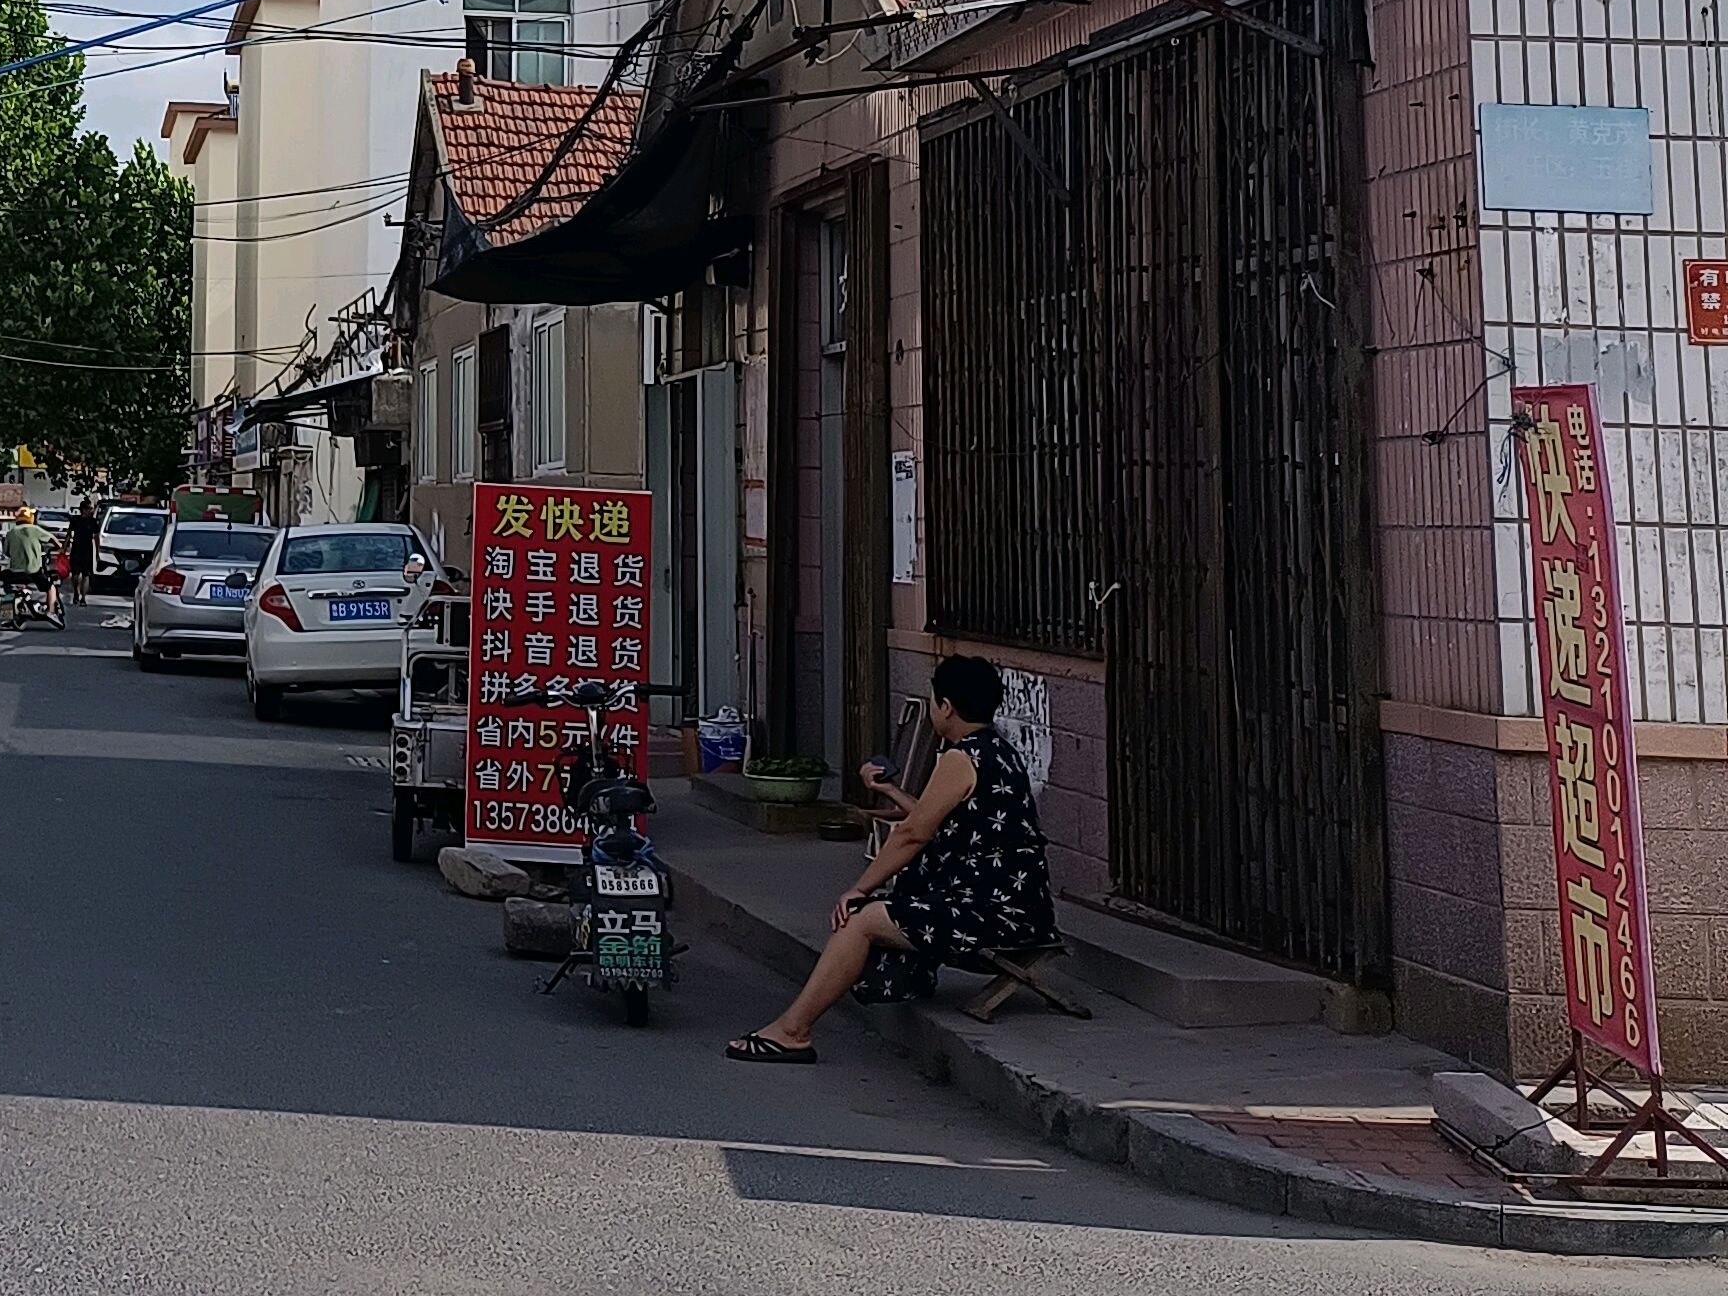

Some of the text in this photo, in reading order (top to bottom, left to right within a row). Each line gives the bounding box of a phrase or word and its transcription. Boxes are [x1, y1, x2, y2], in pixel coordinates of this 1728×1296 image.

[1699, 269, 1728, 287] 有
[493, 494, 631, 544] 发快递
[484, 546, 644, 588] 淘宝退货
[483, 587, 643, 629] 快手退货
[482, 628, 642, 671] 抖音退货
[481, 670, 639, 713] 拼多多货
[1525, 402, 1613, 1026] 快递超市
[597, 909, 661, 935] 立马
